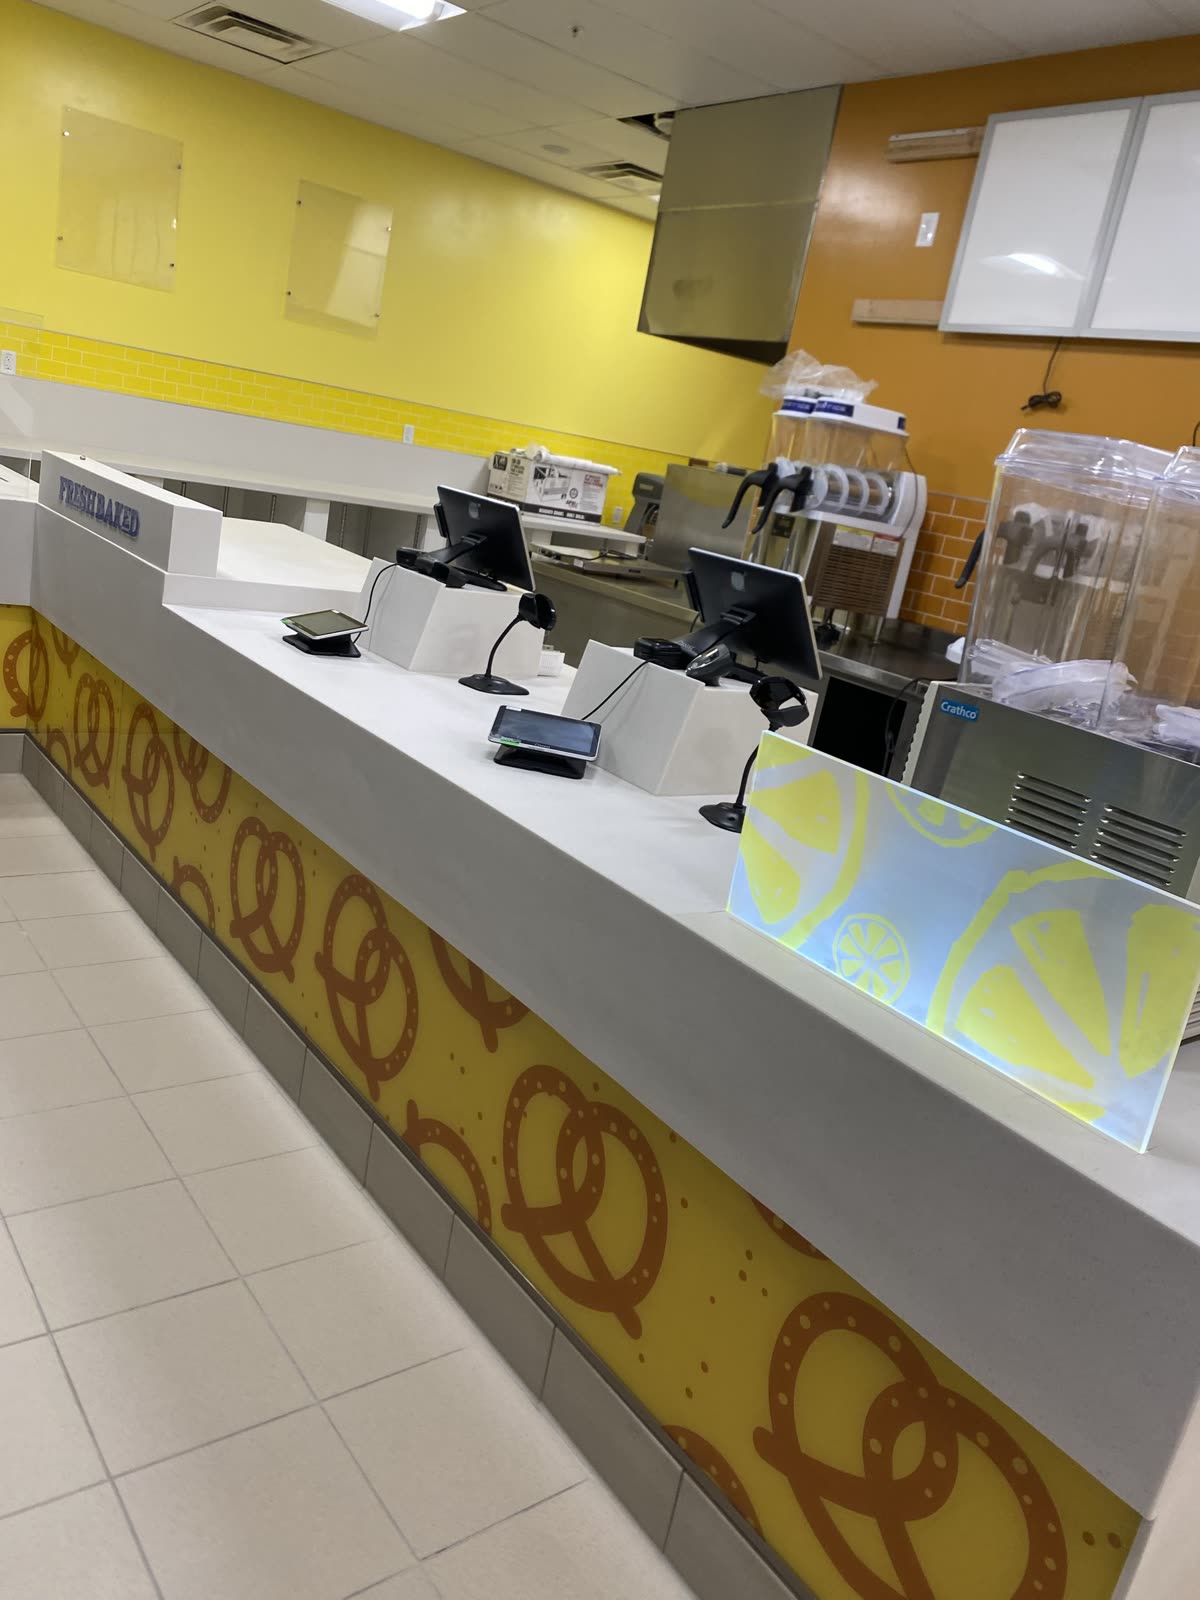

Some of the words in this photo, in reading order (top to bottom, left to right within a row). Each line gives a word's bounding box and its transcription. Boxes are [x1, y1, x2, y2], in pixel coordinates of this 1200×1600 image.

[59, 476, 97, 518] FRESH
[95, 493, 139, 538] BAKED
[941, 701, 977, 719] Crathco
